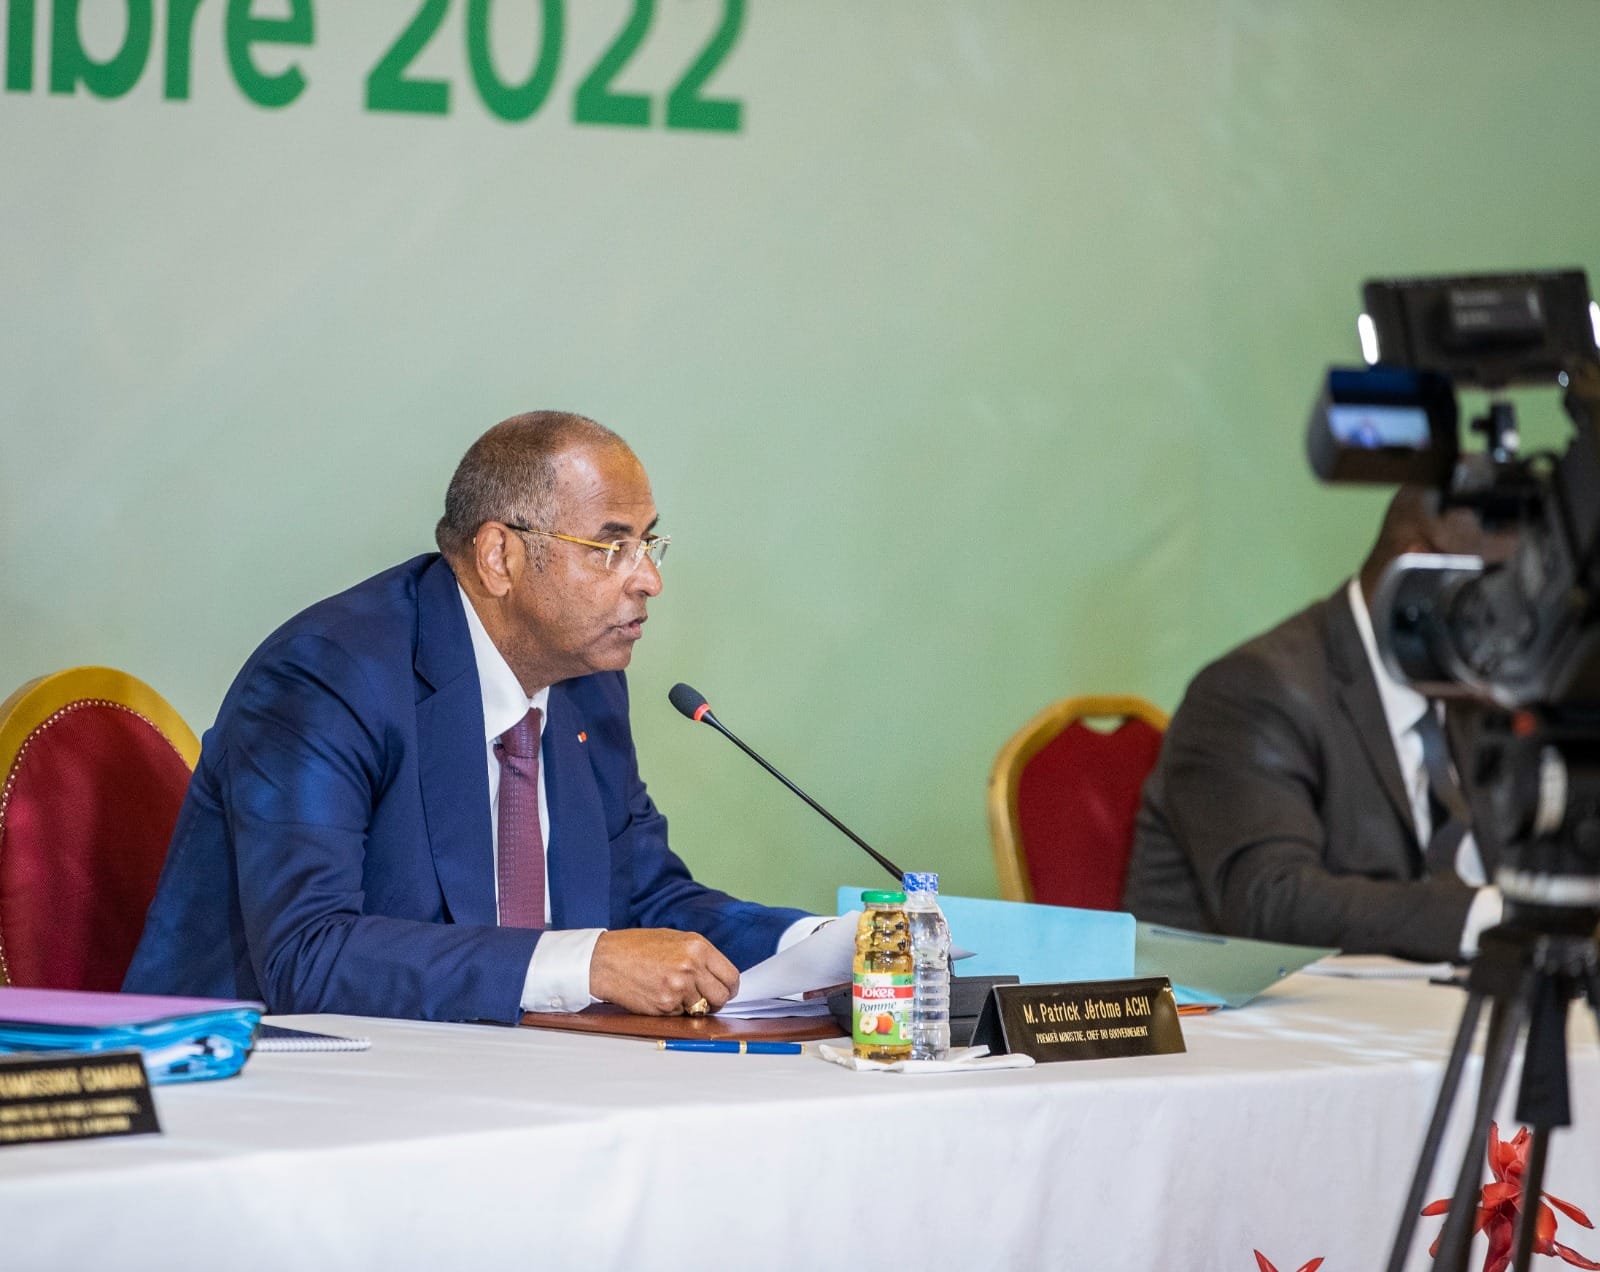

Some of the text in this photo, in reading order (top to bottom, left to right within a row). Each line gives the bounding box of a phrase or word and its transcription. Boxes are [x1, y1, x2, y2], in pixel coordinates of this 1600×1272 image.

[1023, 995, 1151, 1024] M. Patrick Jérôme ACHI
